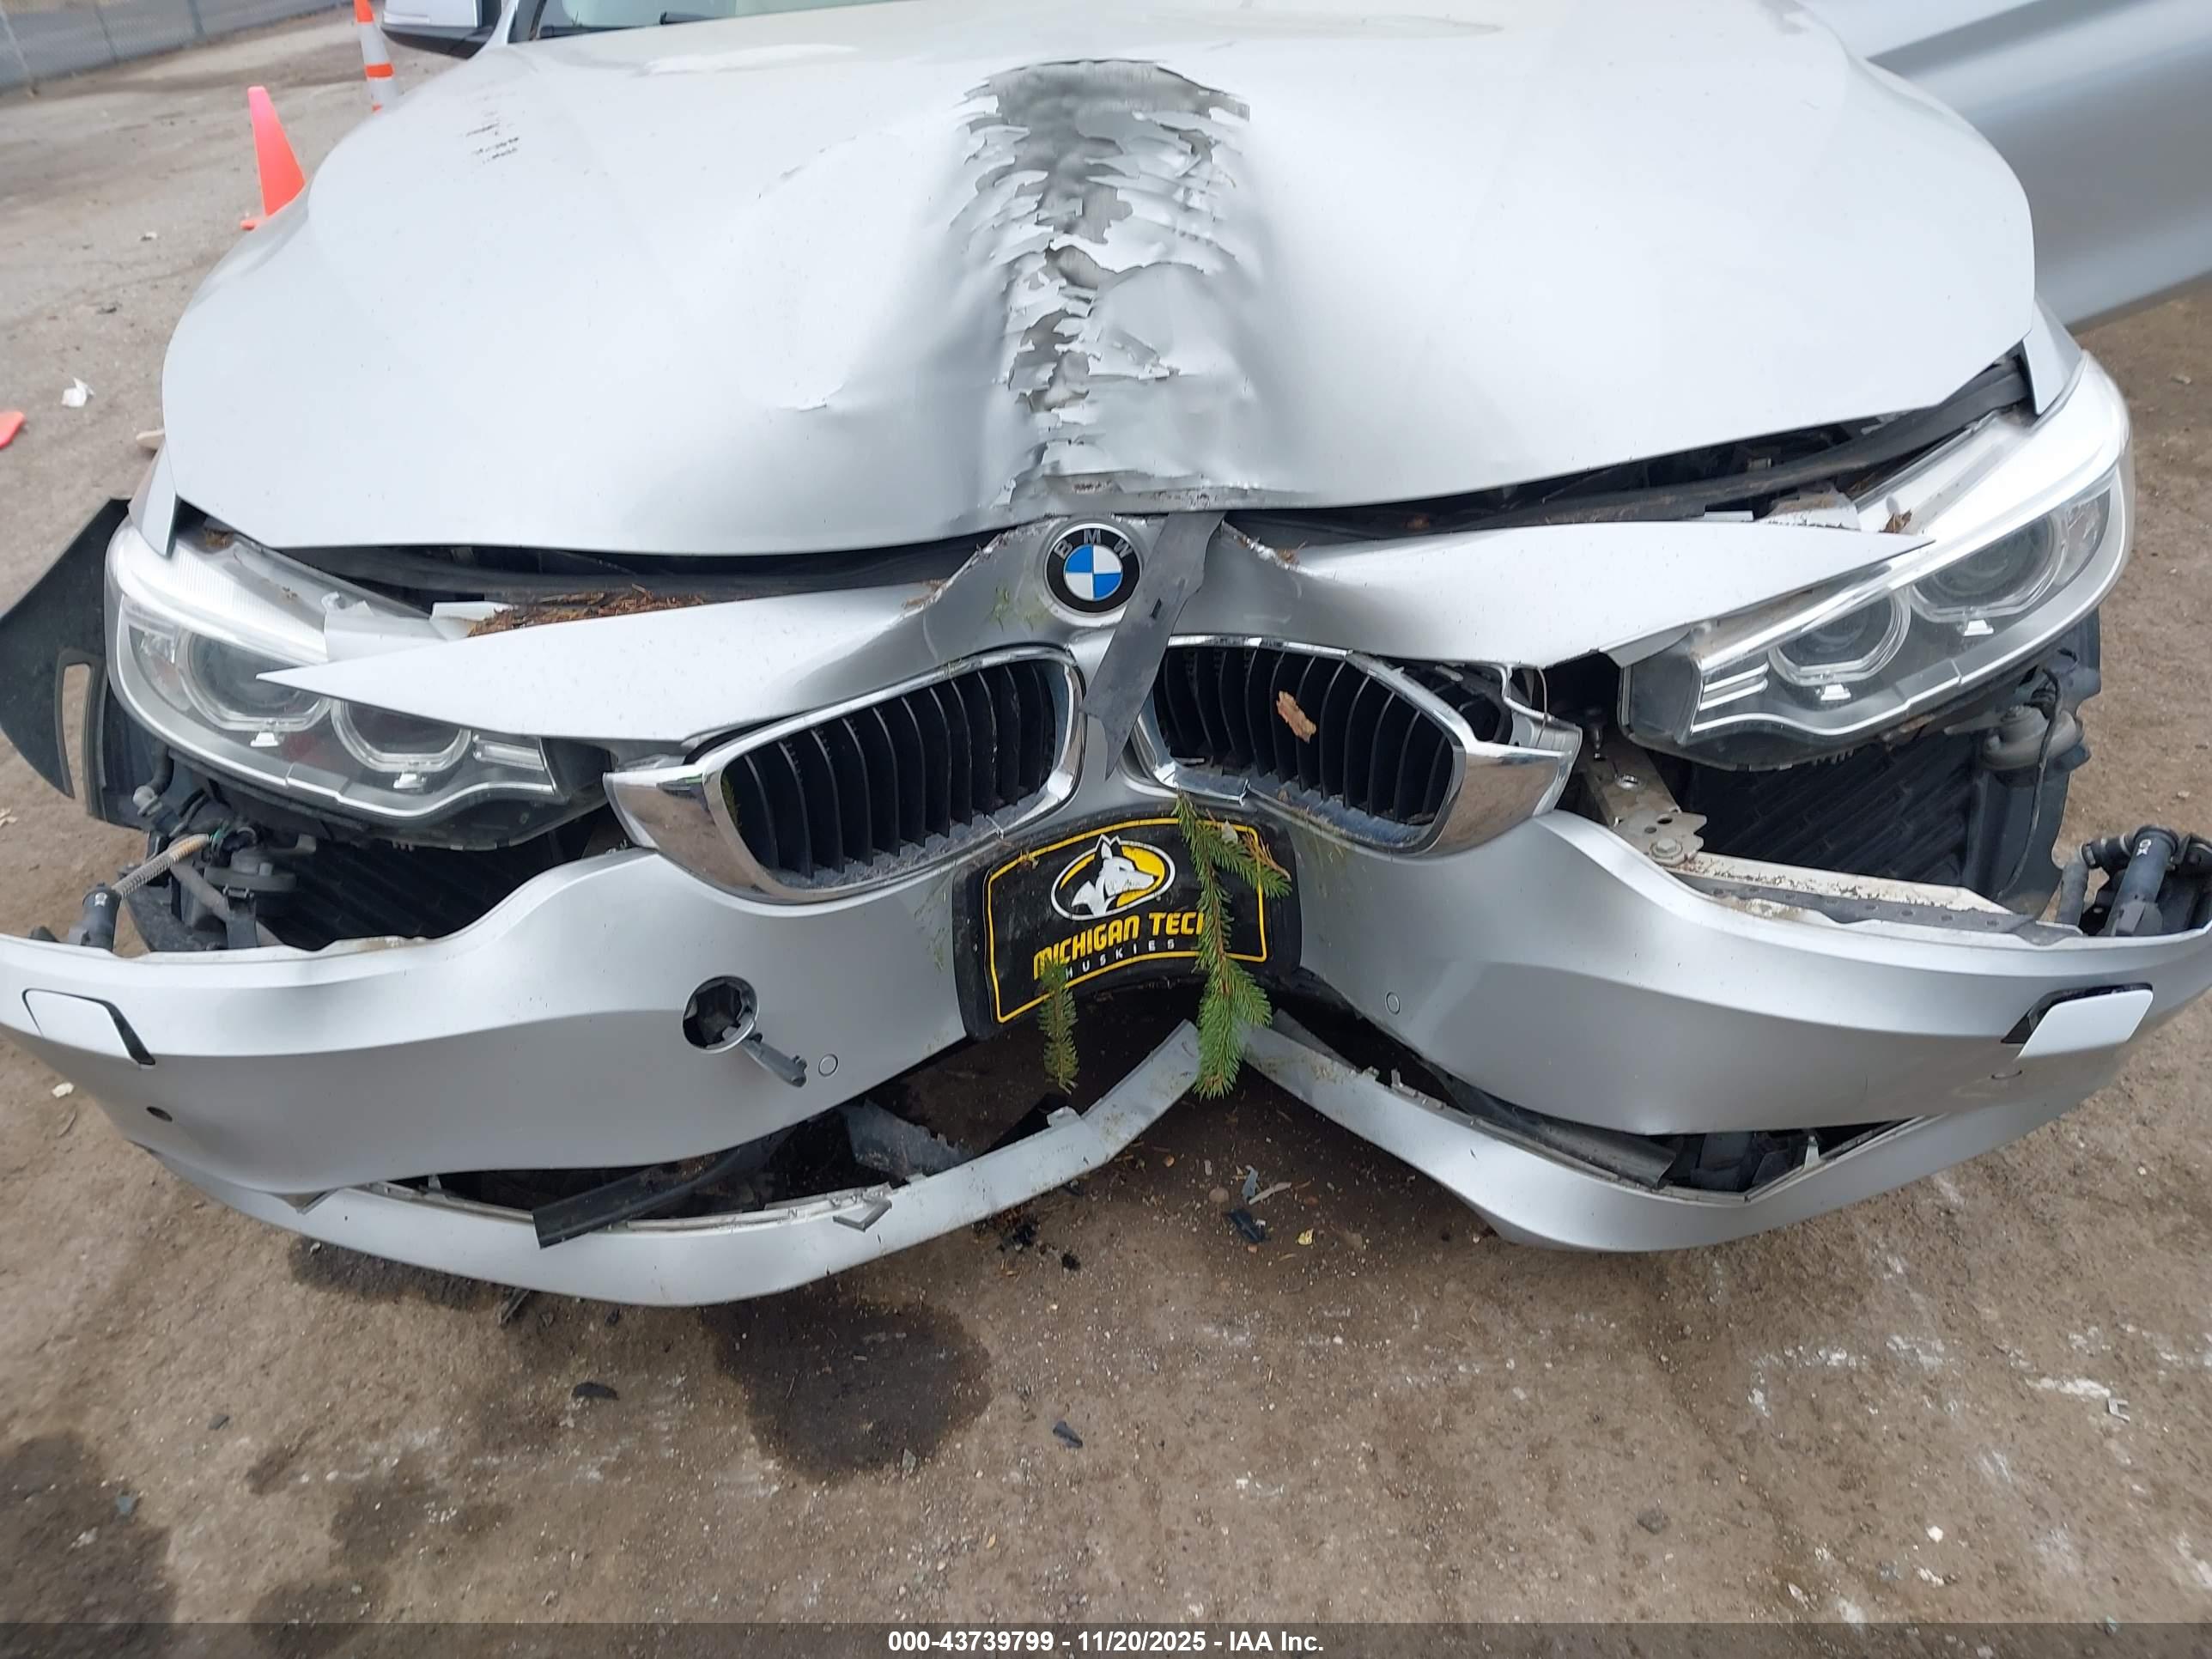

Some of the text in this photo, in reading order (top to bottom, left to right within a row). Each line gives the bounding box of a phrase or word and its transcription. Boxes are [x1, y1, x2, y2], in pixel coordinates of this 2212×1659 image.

[1054, 528, 1133, 560] BMW
[1033, 914, 1140, 981] MICHIGAN
[1065, 939, 1176, 981] HUSKIES
